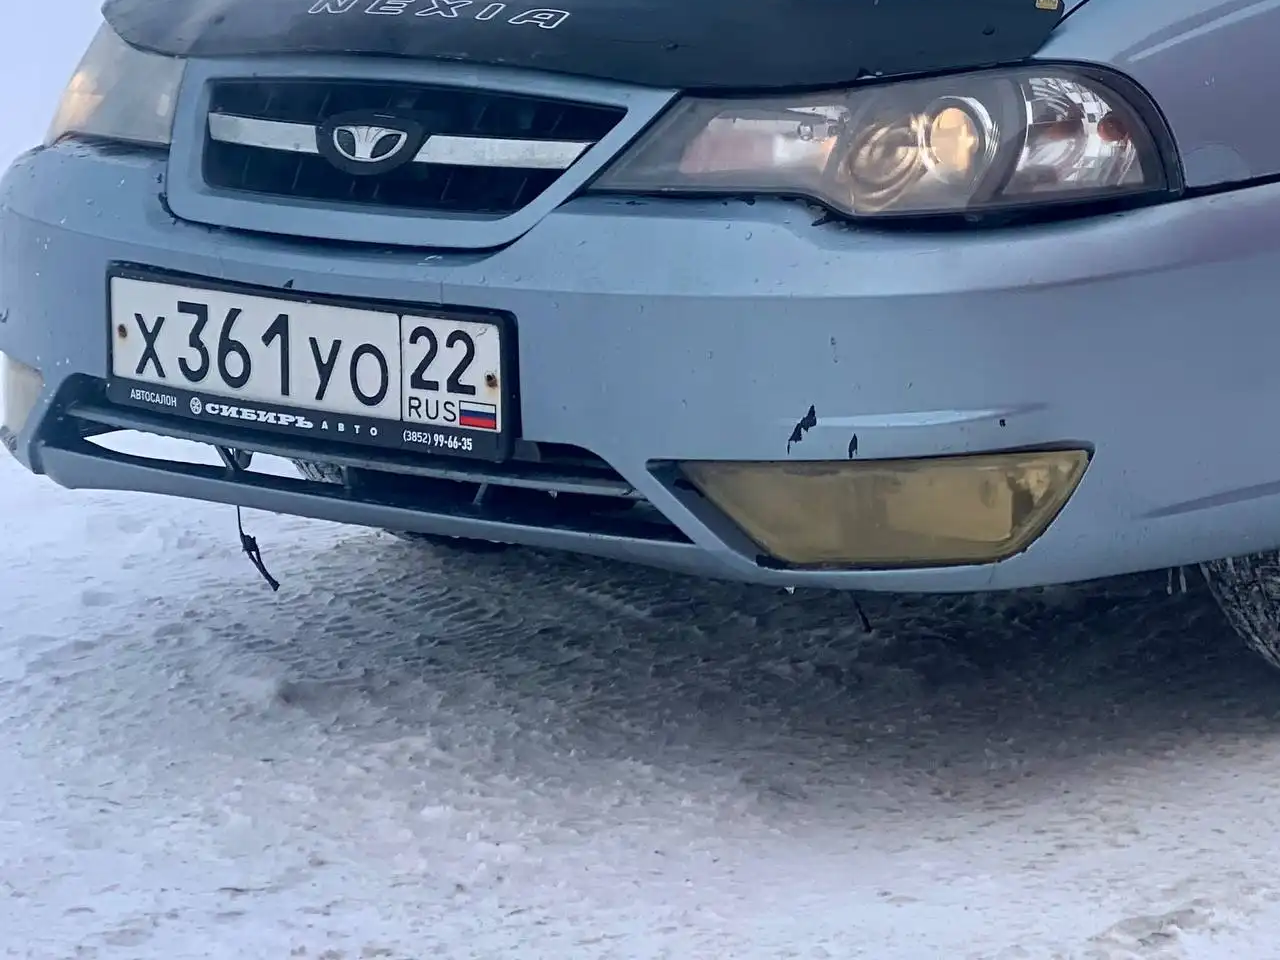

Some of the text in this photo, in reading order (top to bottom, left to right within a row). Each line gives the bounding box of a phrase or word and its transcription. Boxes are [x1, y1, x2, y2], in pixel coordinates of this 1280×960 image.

[408, 325, 477, 396] 22
[130, 388, 177, 408] АВТОСАЛОН
[408, 396, 457, 423] RUS
[205, 402, 314, 429] СИБИРЬ
[402, 429, 473, 452] (3852) 99-66-35
